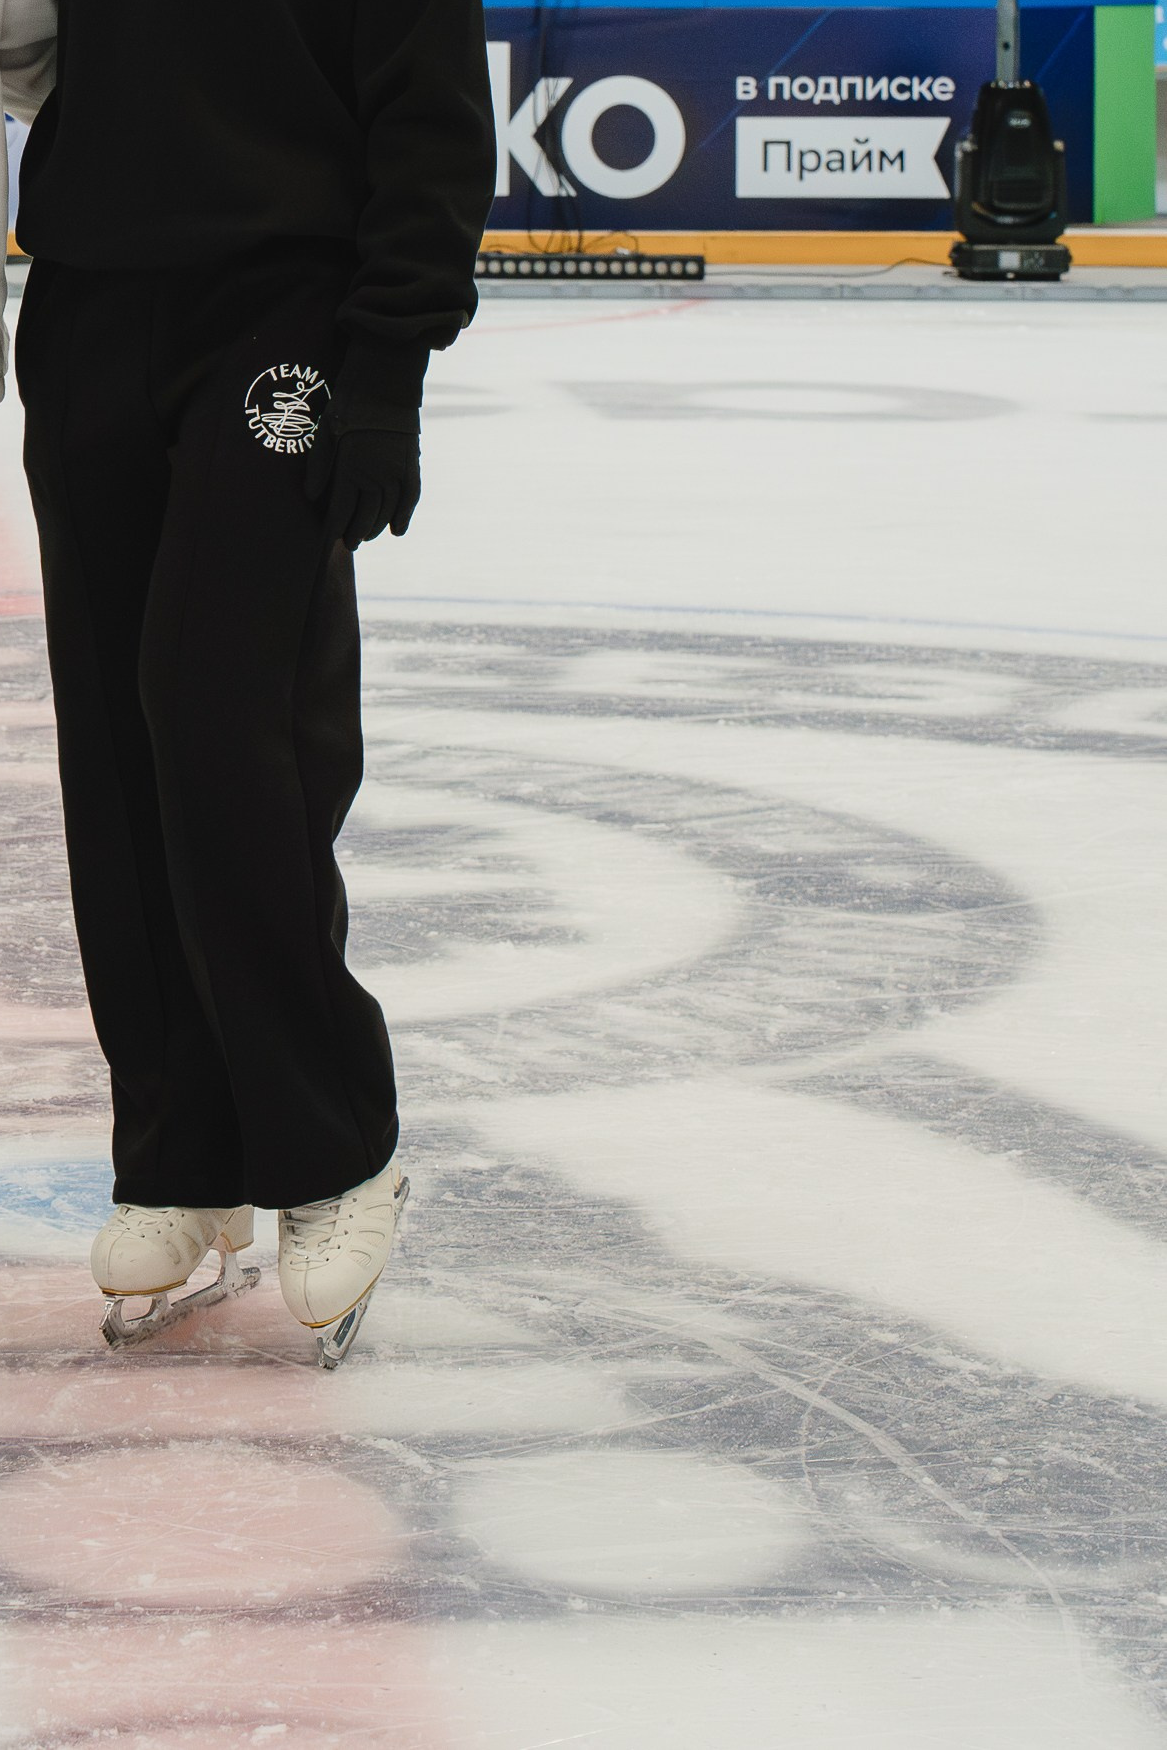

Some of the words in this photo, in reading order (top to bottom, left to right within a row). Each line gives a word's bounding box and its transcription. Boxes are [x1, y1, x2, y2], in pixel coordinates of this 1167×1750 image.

[735, 76, 758, 102] в
[768, 75, 956, 106] подписке
[763, 138, 906, 182] Прайм
[269, 363, 319, 384] TEAM
